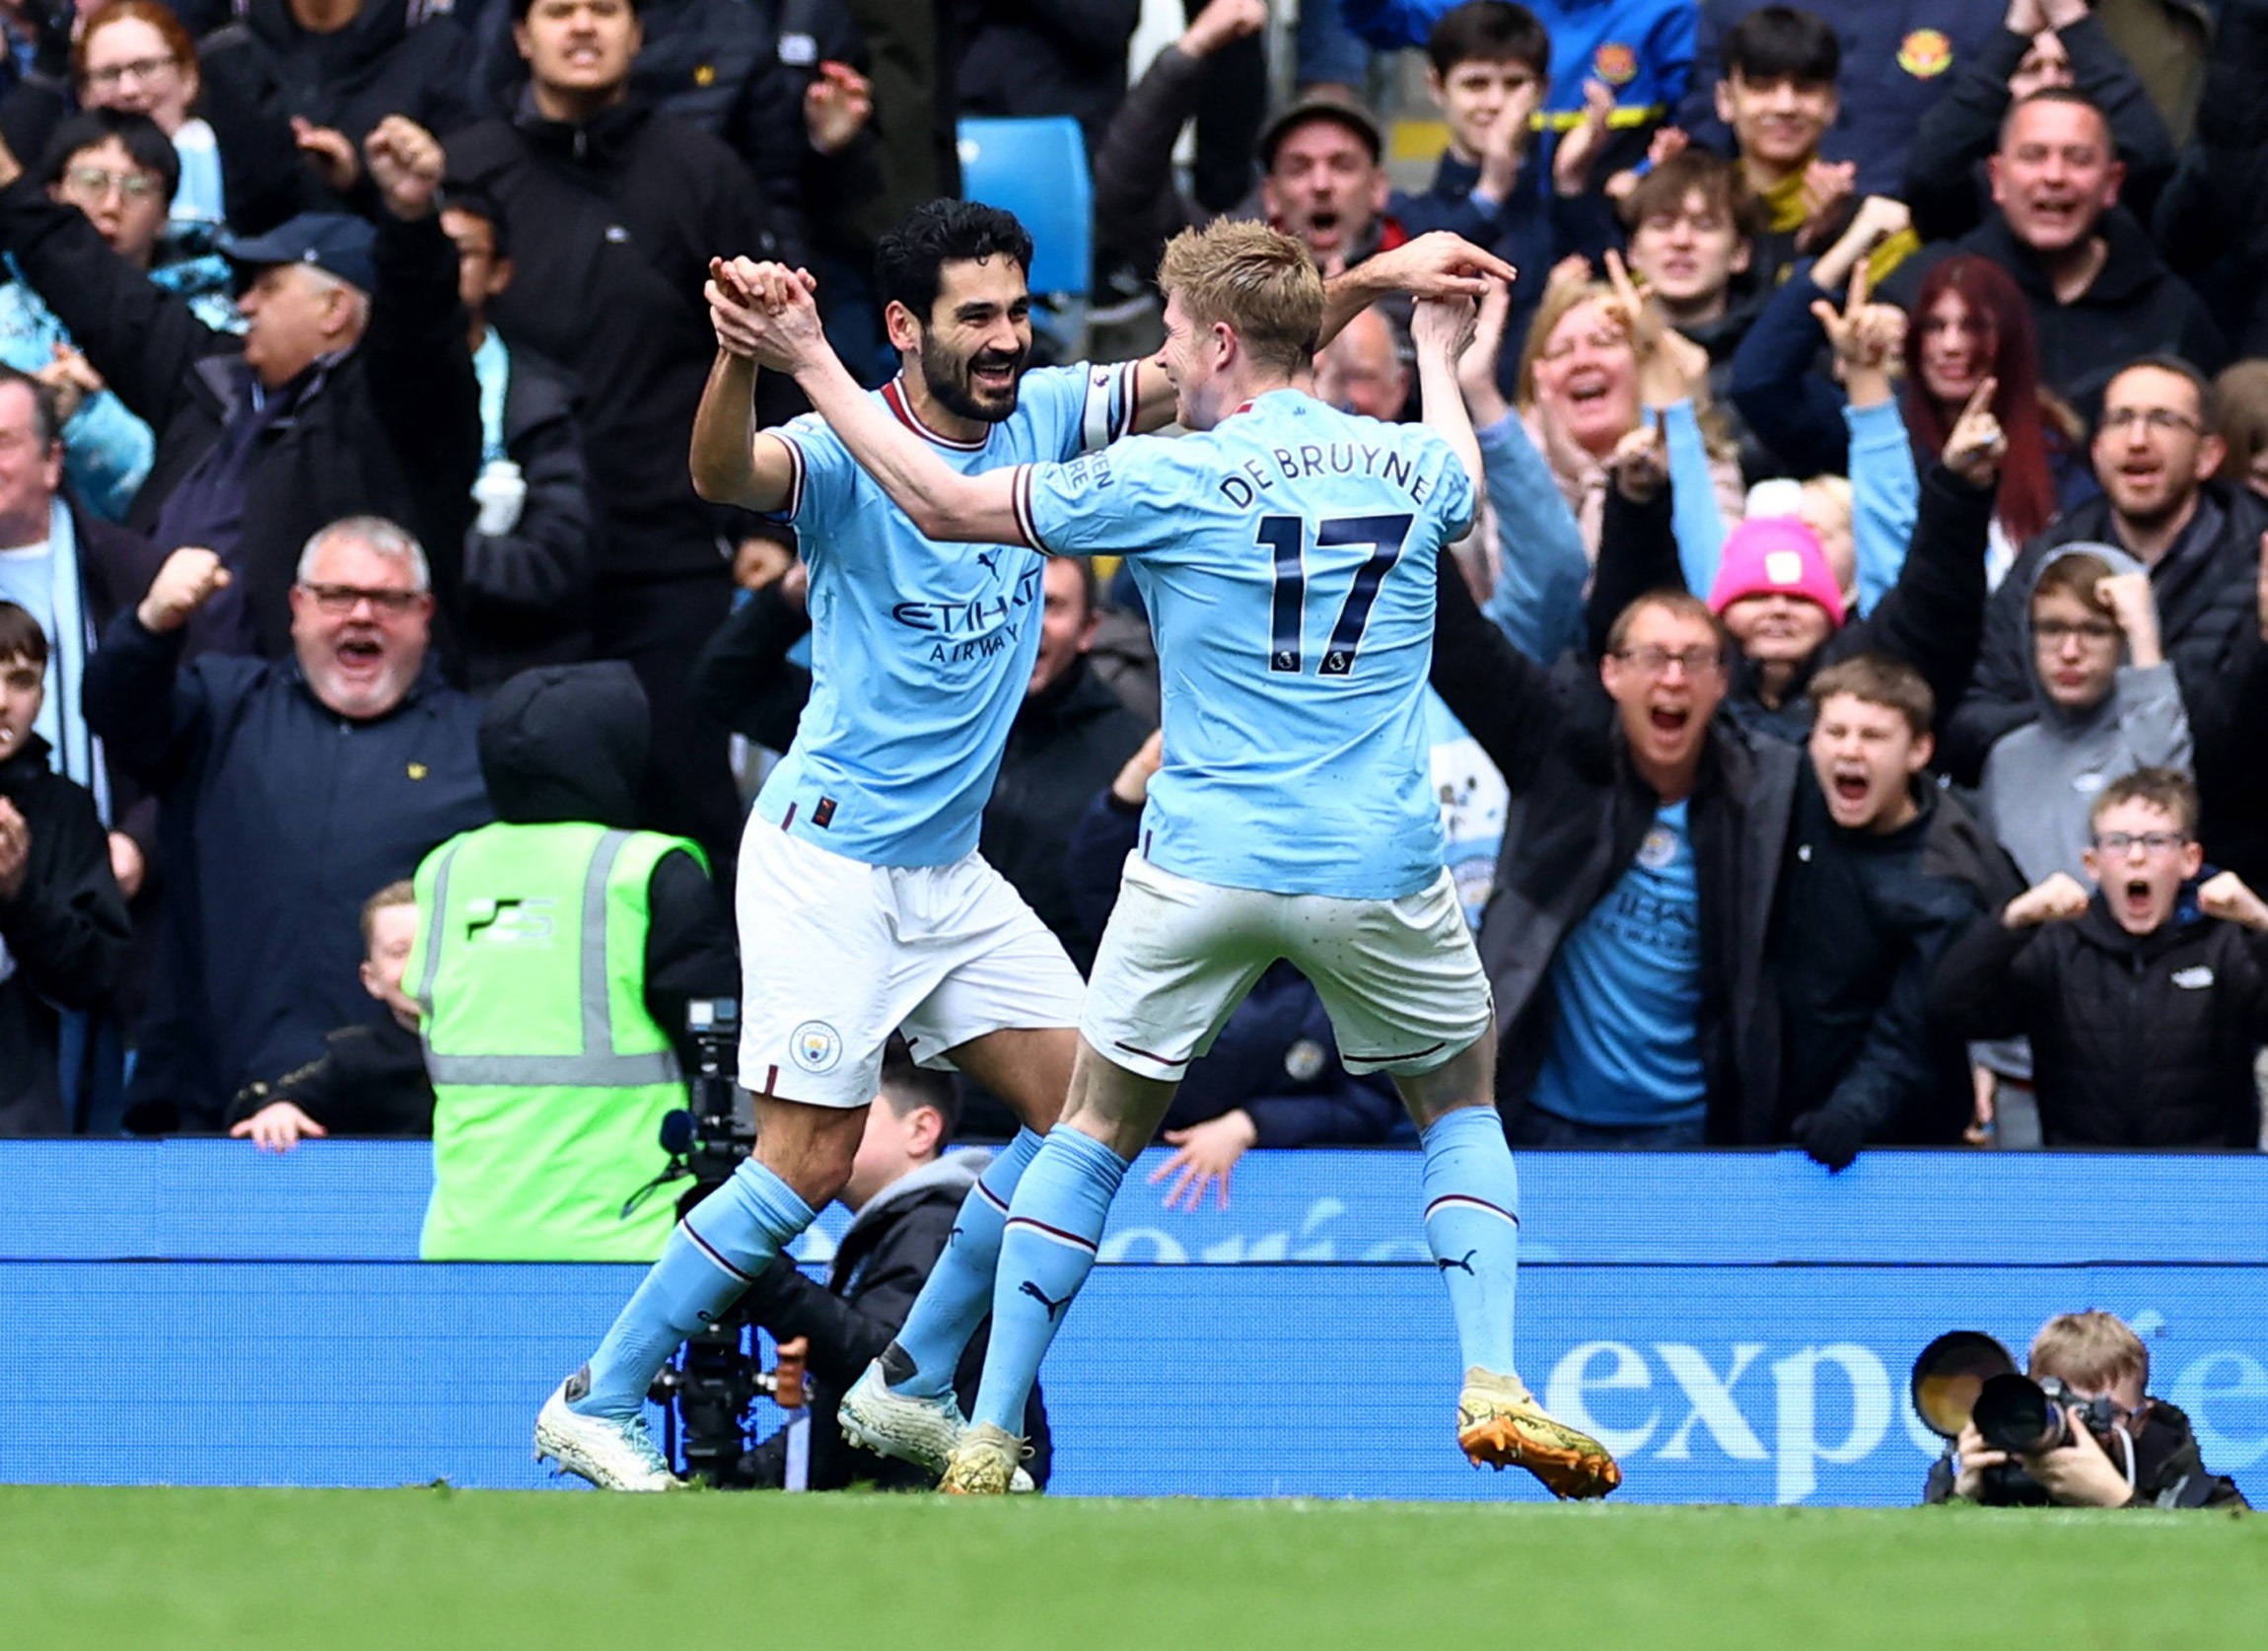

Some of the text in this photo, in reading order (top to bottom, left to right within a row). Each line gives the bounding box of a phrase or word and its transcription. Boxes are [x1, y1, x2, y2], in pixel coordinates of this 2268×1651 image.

[1220, 443, 1431, 509] DE BRUYNE
[1254, 513, 1414, 676] 17
